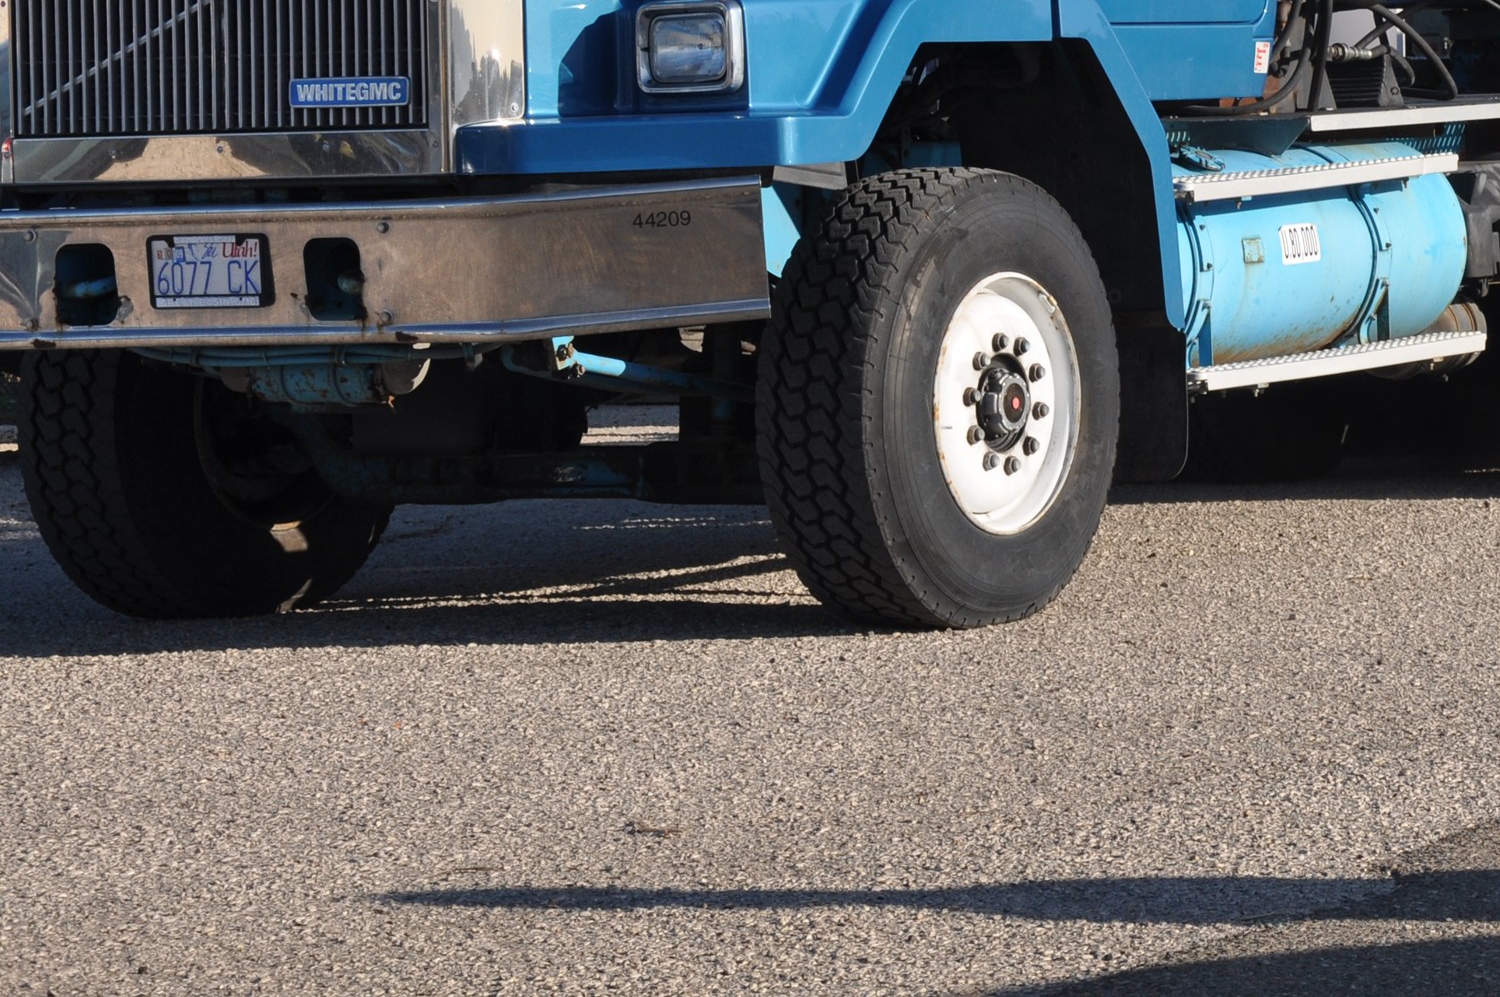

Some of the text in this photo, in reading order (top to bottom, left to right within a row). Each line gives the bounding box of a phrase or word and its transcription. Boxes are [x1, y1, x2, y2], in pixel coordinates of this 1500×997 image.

[296, 82, 402, 102] WHITEGMC
[632, 210, 691, 229] 44209
[157, 260, 260, 296] 6077 CK
